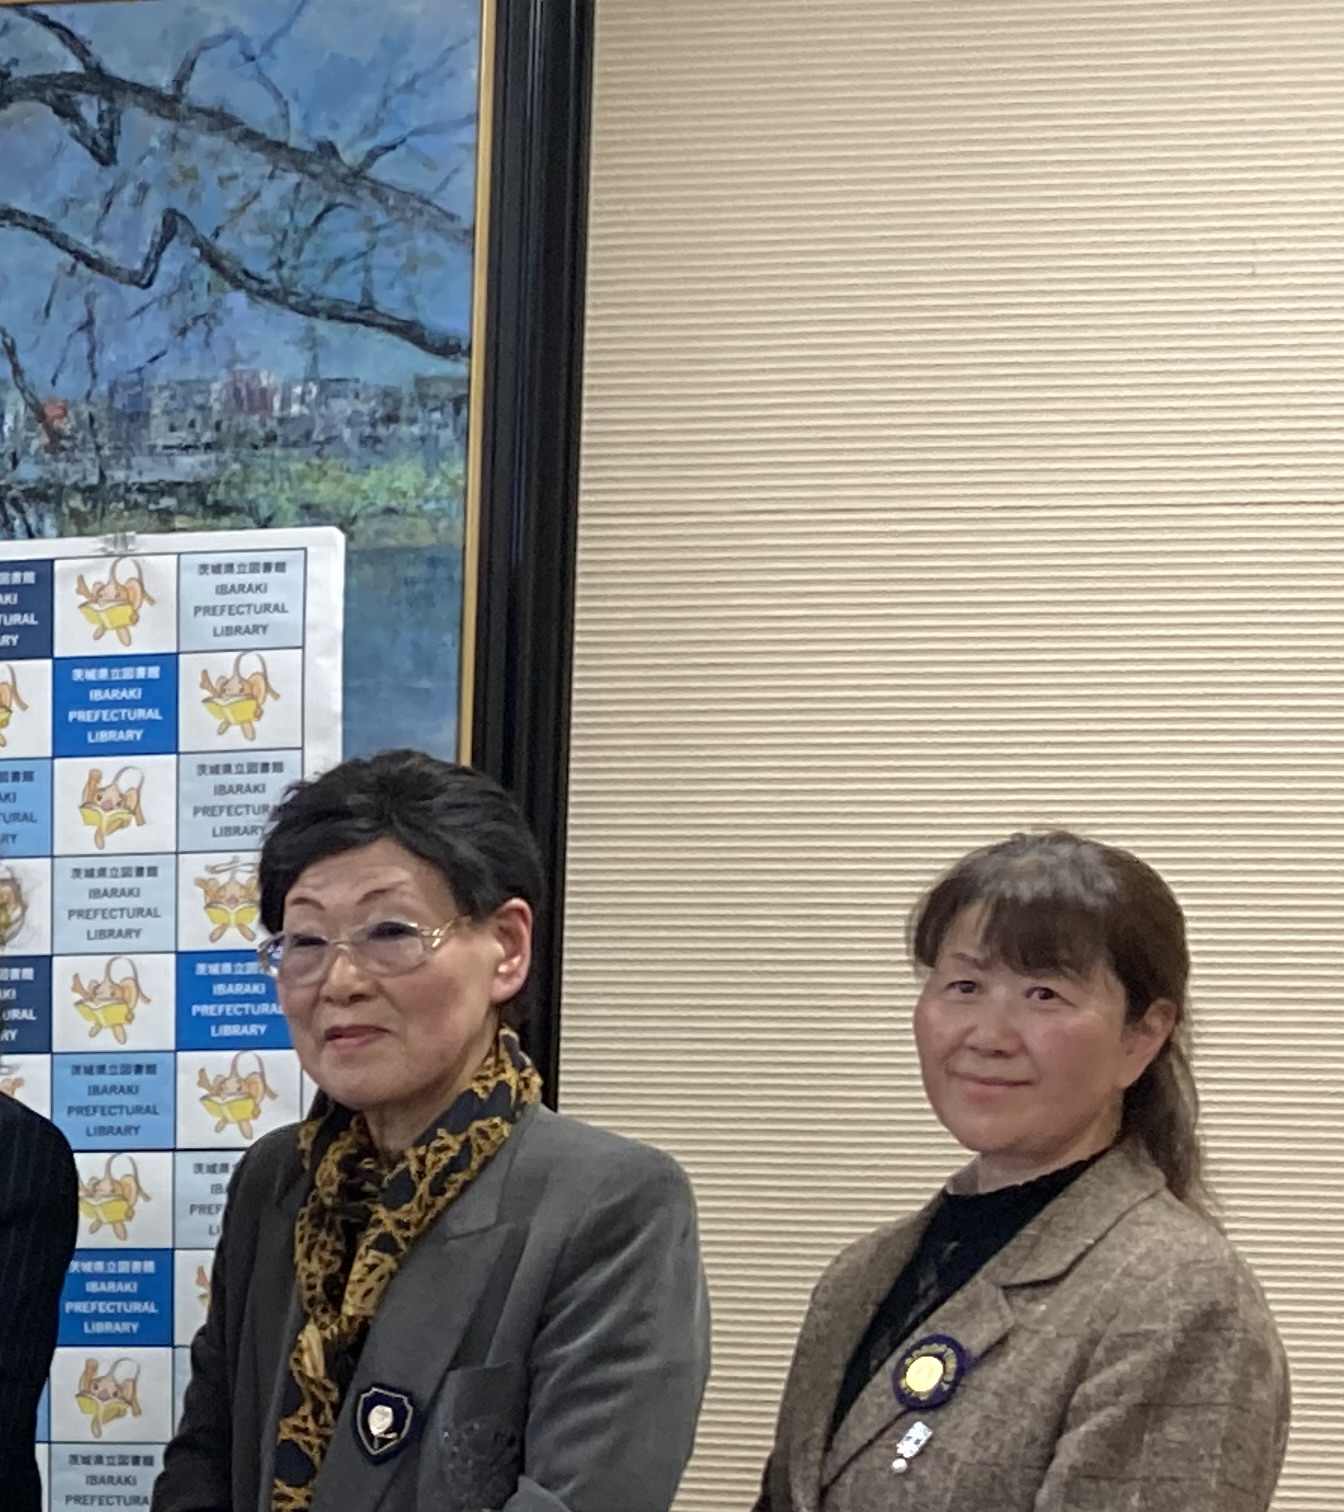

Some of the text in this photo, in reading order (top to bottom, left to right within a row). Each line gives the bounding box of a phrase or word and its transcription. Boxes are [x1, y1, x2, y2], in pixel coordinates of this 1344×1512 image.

[198, 560, 286, 575] 茨城県立図書館
[215, 582, 268, 595] IBARAKI
[194, 602, 289, 617] PREFECTURAL
[213, 624, 269, 637] LIBRARY
[73, 666, 159, 681] 茨城県立図書館
[90, 688, 142, 700] IBARAKI
[69, 708, 163, 722] PREFECTURAL
[88, 729, 143, 742] LIBRARY
[197, 762, 284, 776] 茨城県立図書館
[214, 783, 266, 796] IBARAKI
[72, 865, 158, 879] 茨城県立図書館
[89, 887, 140, 899] IBARAKI
[68, 907, 161, 920] PREFECTURAL
[87, 928, 142, 940] LIBRARY
[213, 983, 265, 995] IBARAKI
[211, 1024, 267, 1037] LIBRARY
[71, 1063, 157, 1076] 茨城県立図書館
[88, 1084, 139, 1096] IBARAKI
[67, 1104, 160, 1117] PREFECTURAL
[86, 1125, 141, 1137] LIBRARY
[70, 1261, 155, 1273] 茨城県立図書館
[86, 1281, 137, 1292] IBARAKI
[66, 1302, 158, 1313] PREFECTURAL
[84, 1322, 139, 1333] LIBRARY
[69, 1454, 154, 1466] 茨城県立図書館
[86, 1474, 137, 1486] IBARAKI
[65, 1494, 149, 1506] PREFECTURA
